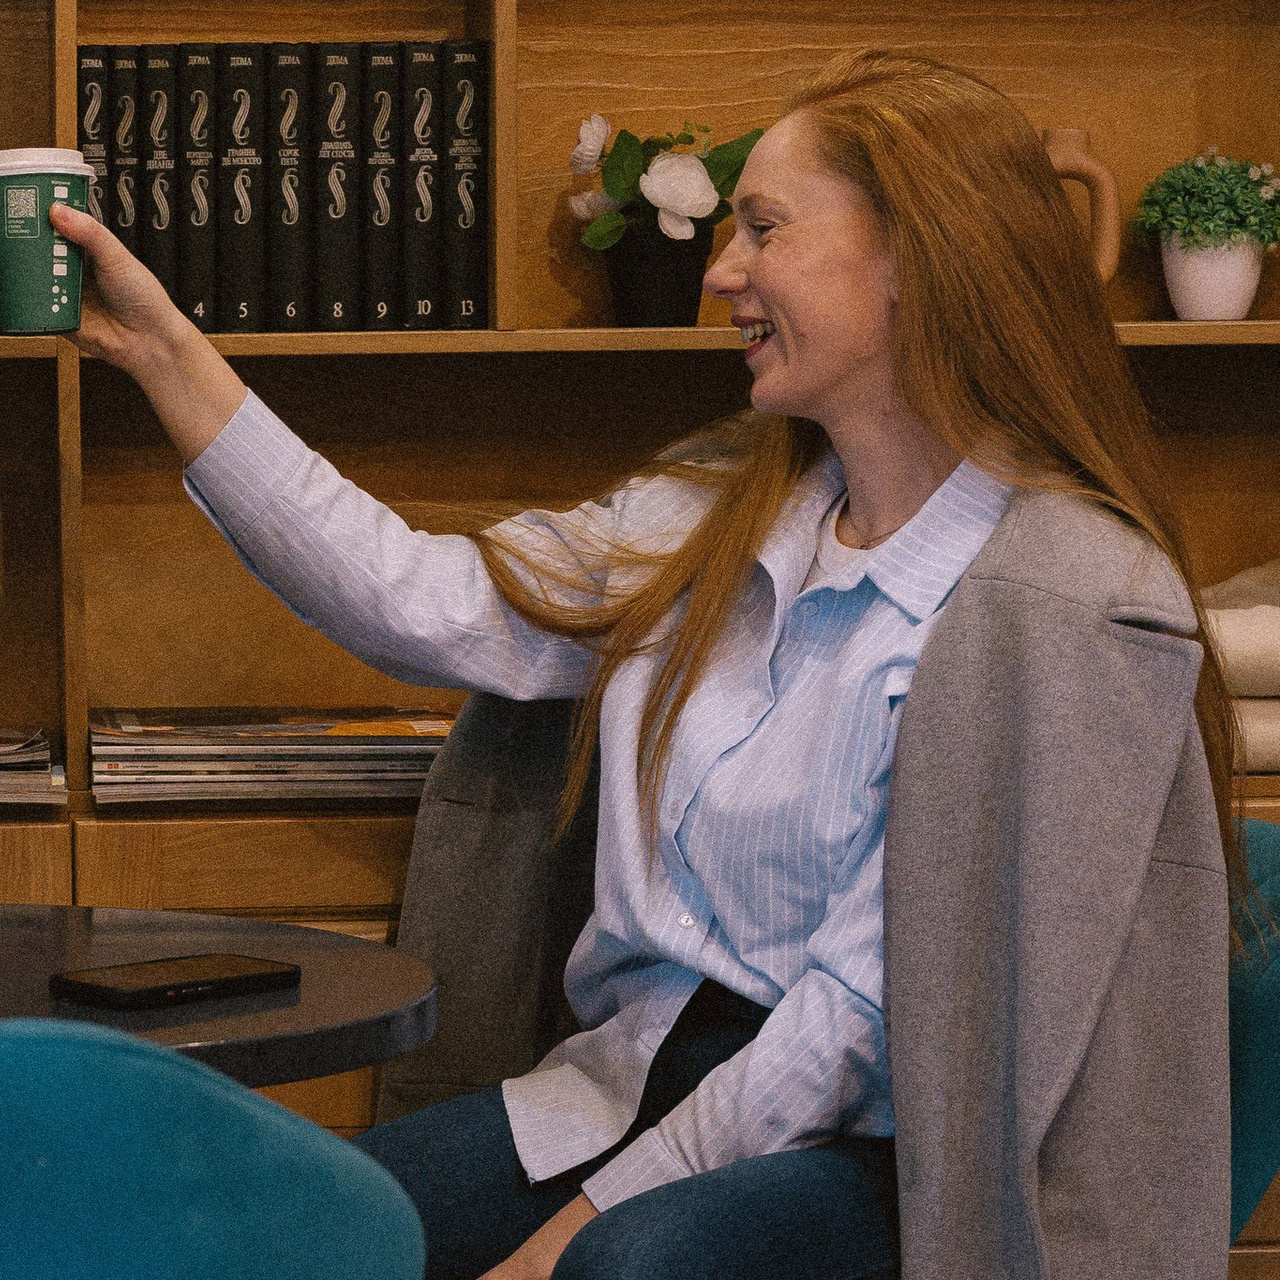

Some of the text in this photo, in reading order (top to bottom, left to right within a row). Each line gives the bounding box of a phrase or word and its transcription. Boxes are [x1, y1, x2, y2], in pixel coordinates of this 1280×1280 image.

[194, 302, 205, 317] 4
[239, 302, 248, 318] 5
[286, 302, 296, 317] 6
[333, 302, 343, 318] 8
[377, 302, 387, 318] 9
[417, 300, 431, 315] 10
[461, 300, 474, 316] 13
